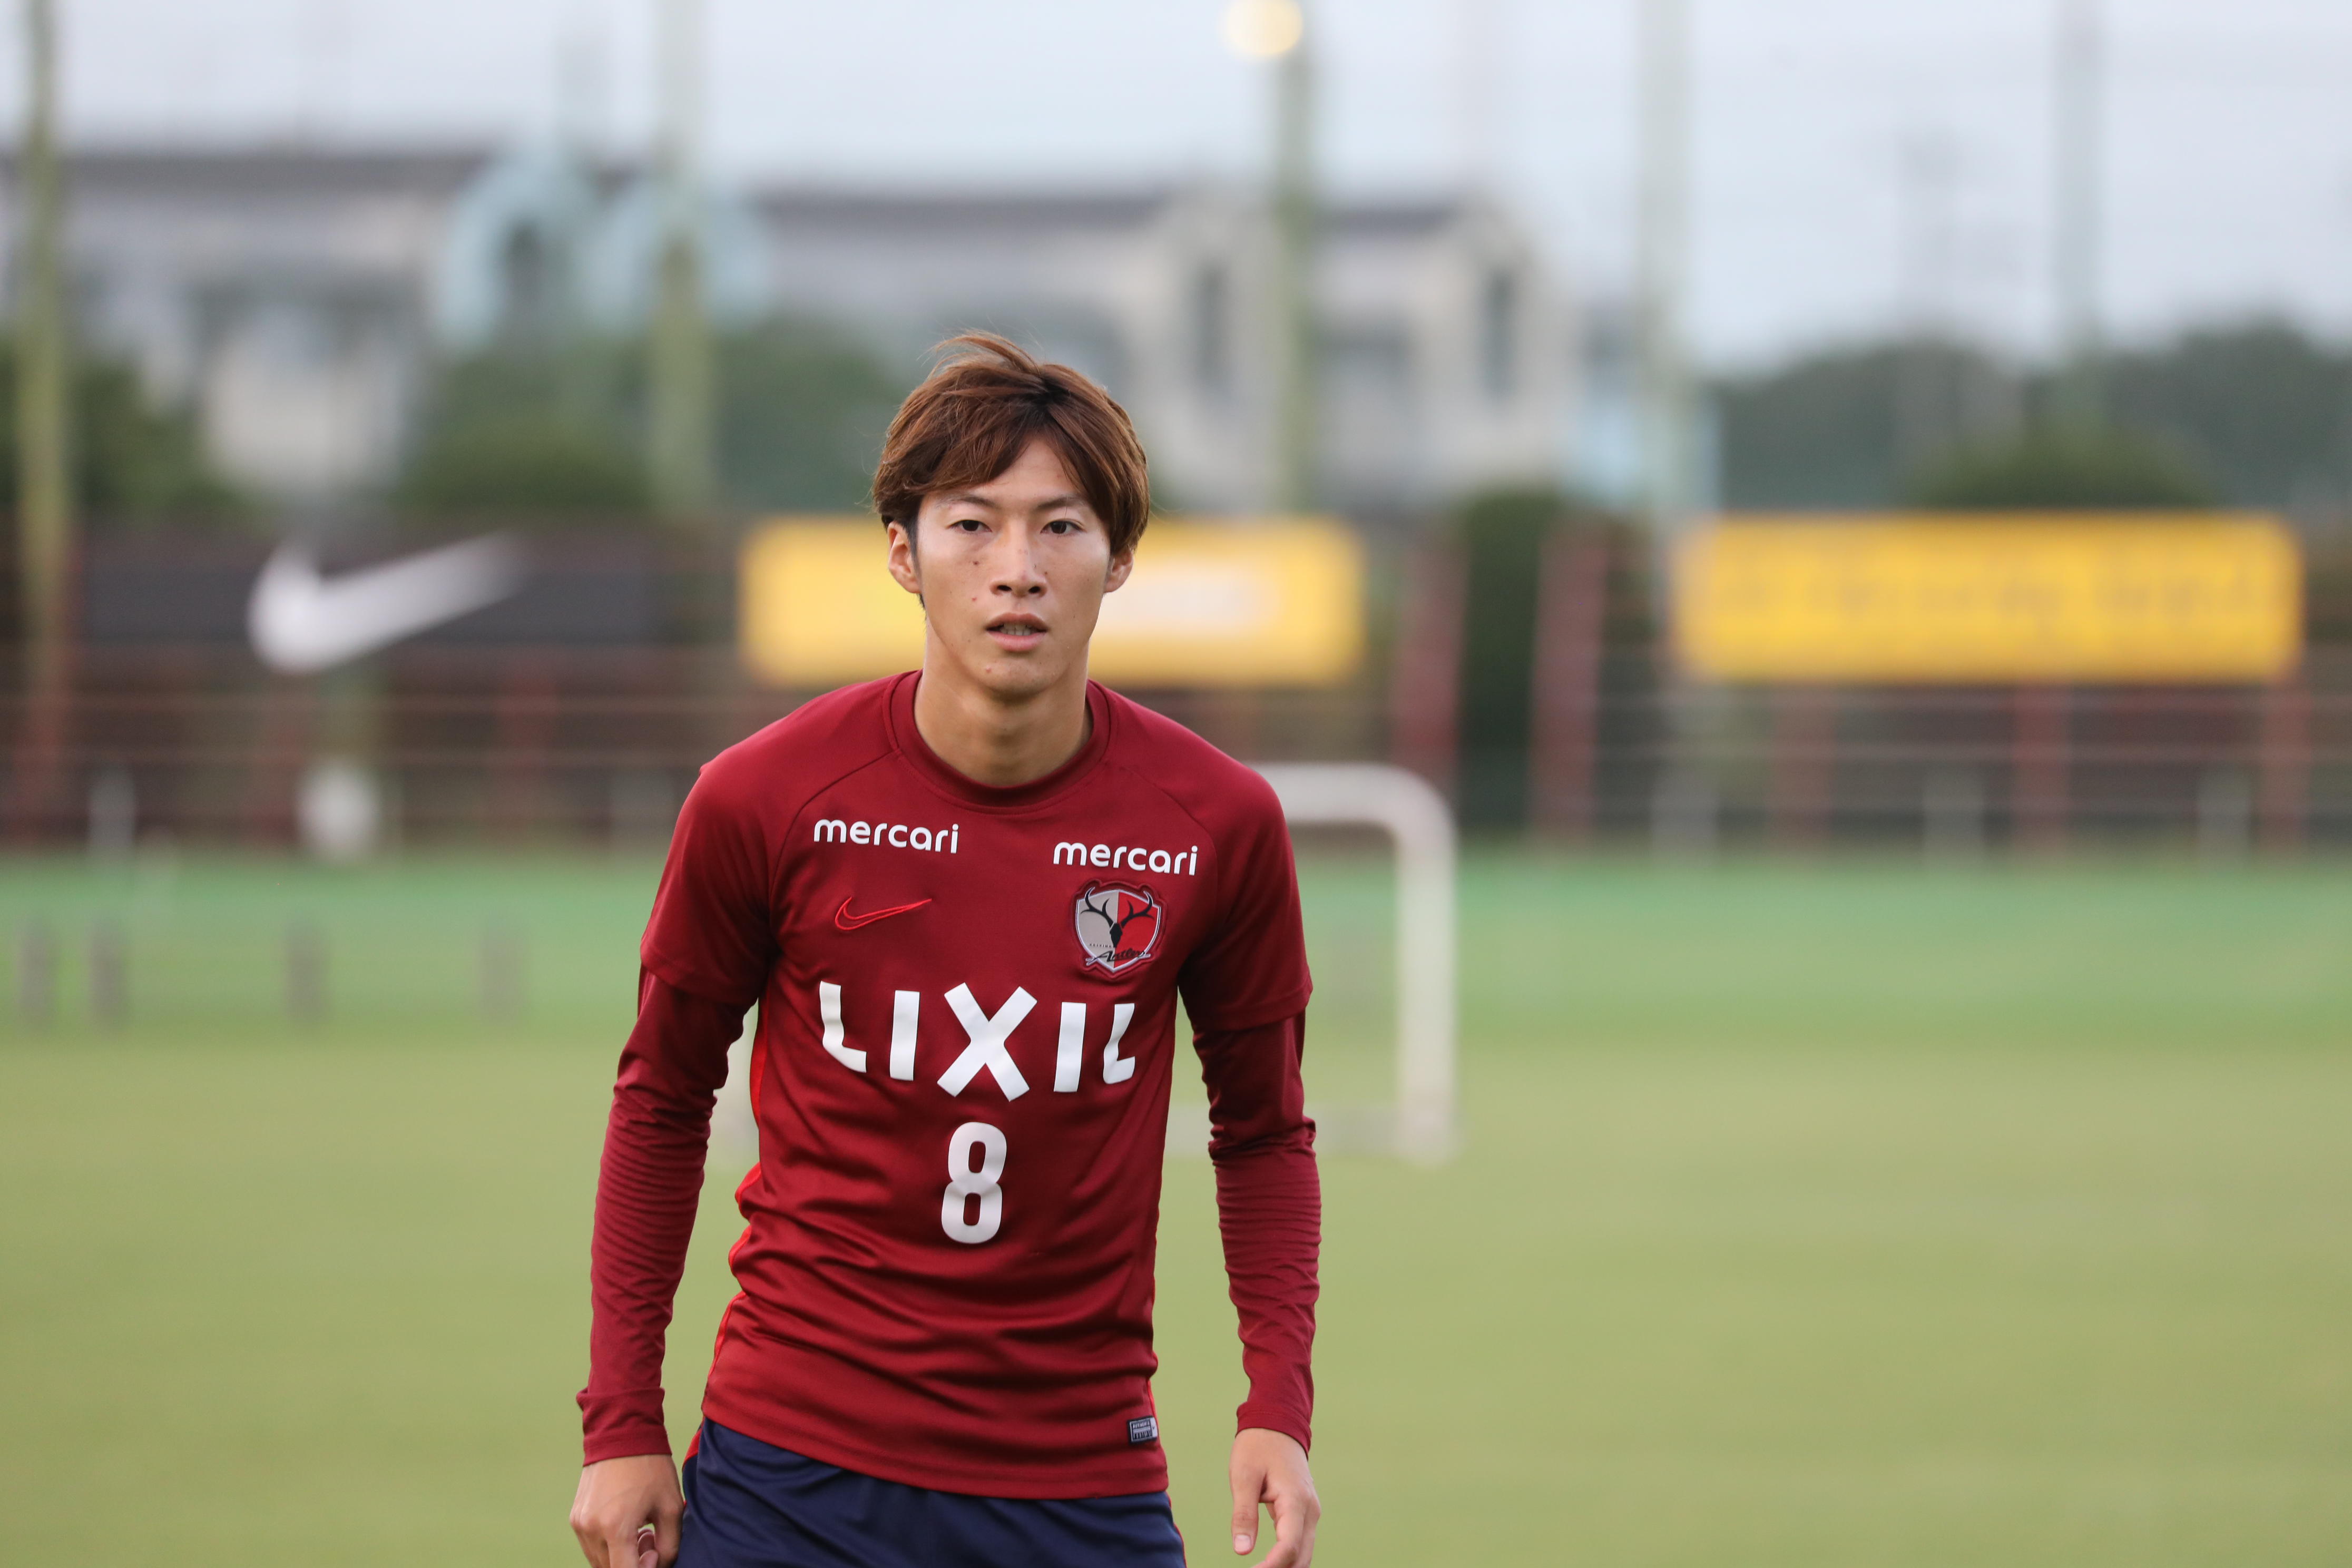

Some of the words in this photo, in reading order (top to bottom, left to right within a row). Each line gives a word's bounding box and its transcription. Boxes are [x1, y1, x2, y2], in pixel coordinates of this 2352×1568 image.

[814, 819, 959, 854] mercari
[1053, 841, 1199, 876] mercari
[819, 981, 1136, 1102] LIXIL
[941, 1121, 1007, 1244] 8
